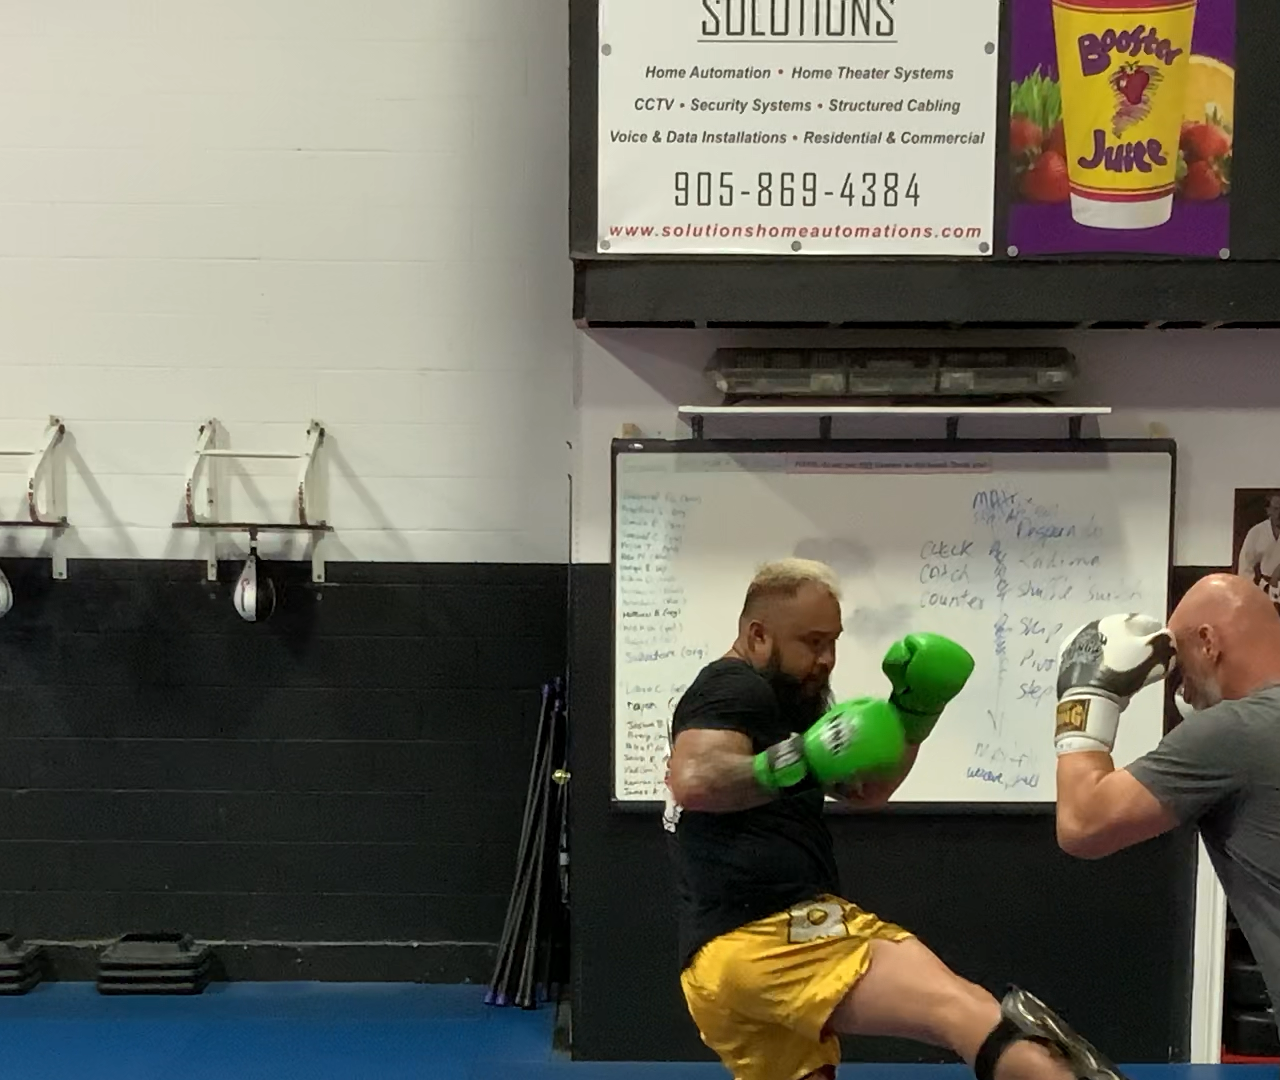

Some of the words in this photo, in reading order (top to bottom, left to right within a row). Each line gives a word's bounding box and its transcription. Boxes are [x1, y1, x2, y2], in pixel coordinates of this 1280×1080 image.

[701, 0, 895, 36] SOLUTIONS
[1078, 25, 1183, 77] Booster
[645, 65, 687, 79] Home
[689, 65, 772, 79] Automation
[791, 66, 833, 80] Home
[837, 66, 890, 80] Theater
[893, 66, 955, 83] Systems
[634, 97, 675, 111] CCTV
[690, 97, 748, 114] Security
[751, 98, 812, 115] Systems
[828, 98, 904, 112] Structured
[907, 98, 961, 115] Cabling
[610, 130, 648, 143] Voice
[652, 130, 662, 143] &
[666, 130, 698, 143] Data
[701, 130, 787, 144] Installations
[803, 130, 883, 144] Residential
[886, 131, 896, 144] &
[900, 131, 986, 145] Commercial
[1077, 129, 1167, 173] Juice
[675, 171, 920, 207] 905-869-4384
[608, 223, 982, 239] www.solutionshomeautomations.com
